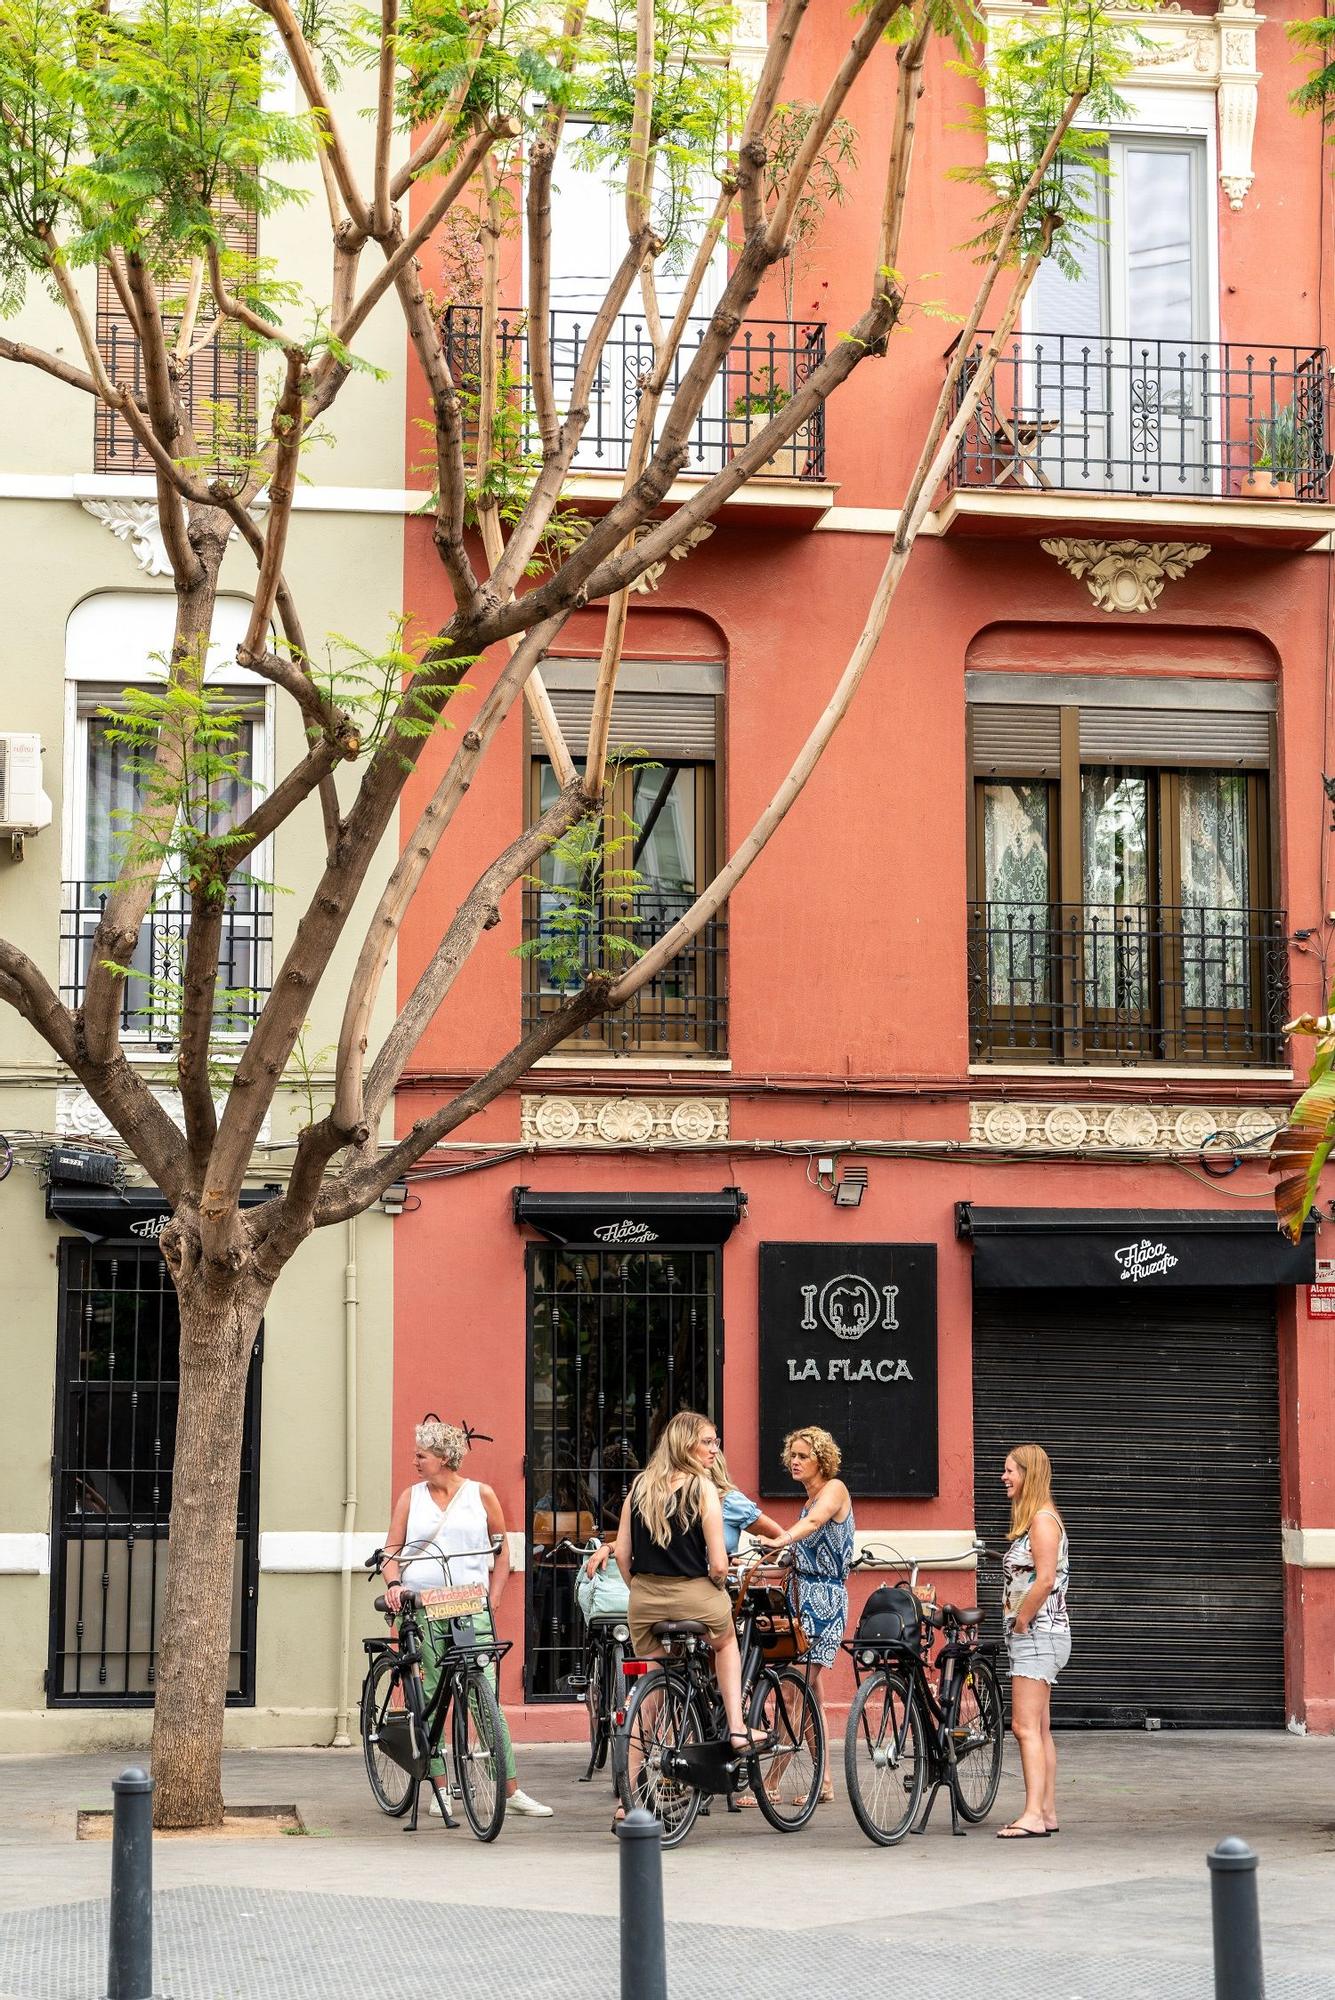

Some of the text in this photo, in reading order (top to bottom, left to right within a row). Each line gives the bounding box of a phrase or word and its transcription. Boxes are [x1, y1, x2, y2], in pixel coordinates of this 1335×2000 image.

[129, 1218, 168, 1237] Fla
[593, 1222, 649, 1242] Flaca
[621, 1219, 634, 1228] La
[1140, 1239, 1152, 1250] La
[1114, 1243, 1167, 1268] Flaca
[1120, 1253, 1179, 1282] de Ruzafa
[787, 1359, 914, 1382] LA FLACA
